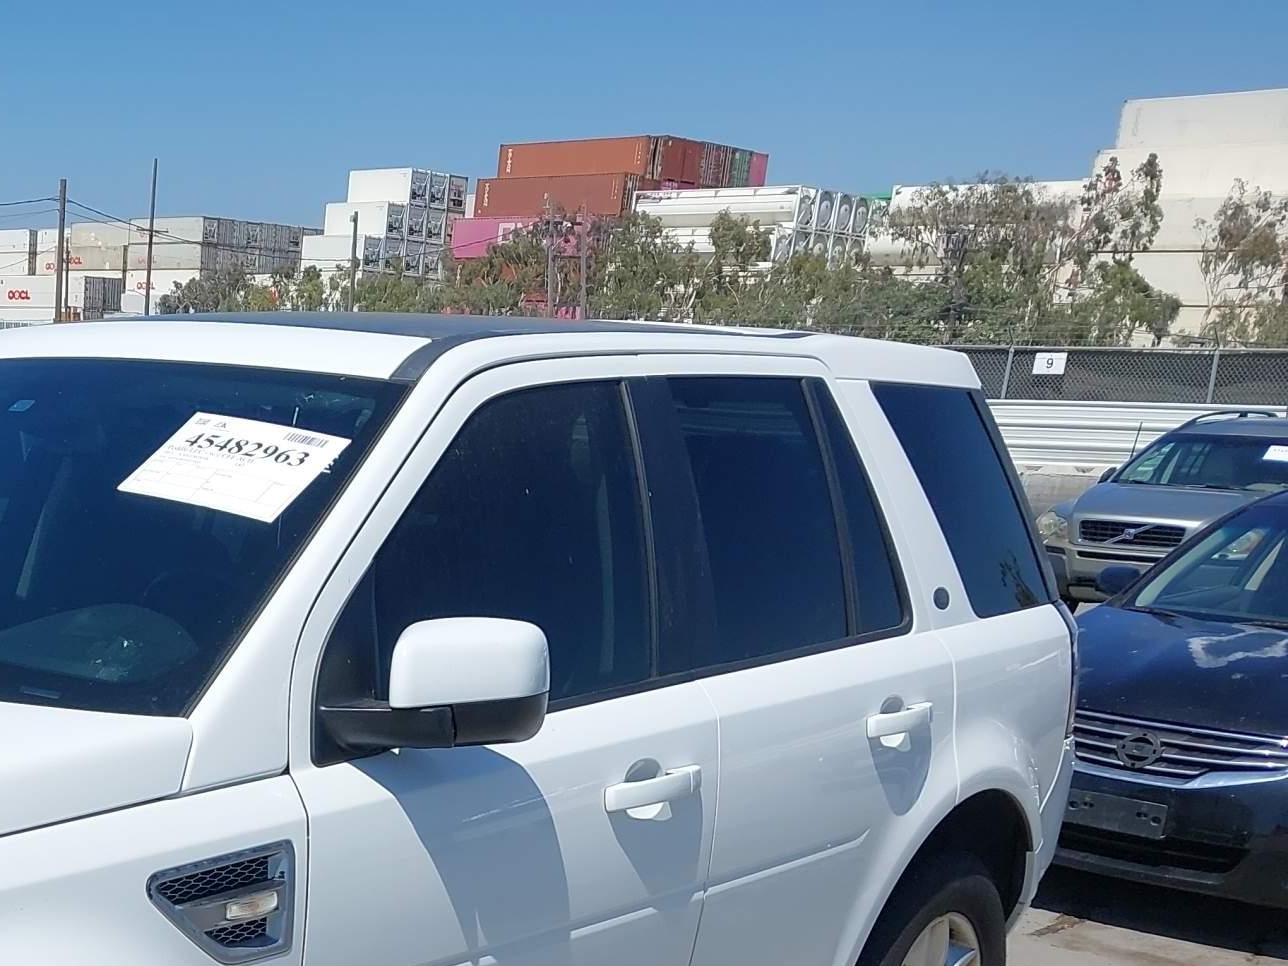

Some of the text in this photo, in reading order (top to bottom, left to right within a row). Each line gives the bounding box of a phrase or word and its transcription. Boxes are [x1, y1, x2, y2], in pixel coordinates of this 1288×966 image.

[8, 290, 31, 300] OOCL
[1046, 357, 1054, 369] 9
[185, 432, 310, 467] 45482963
